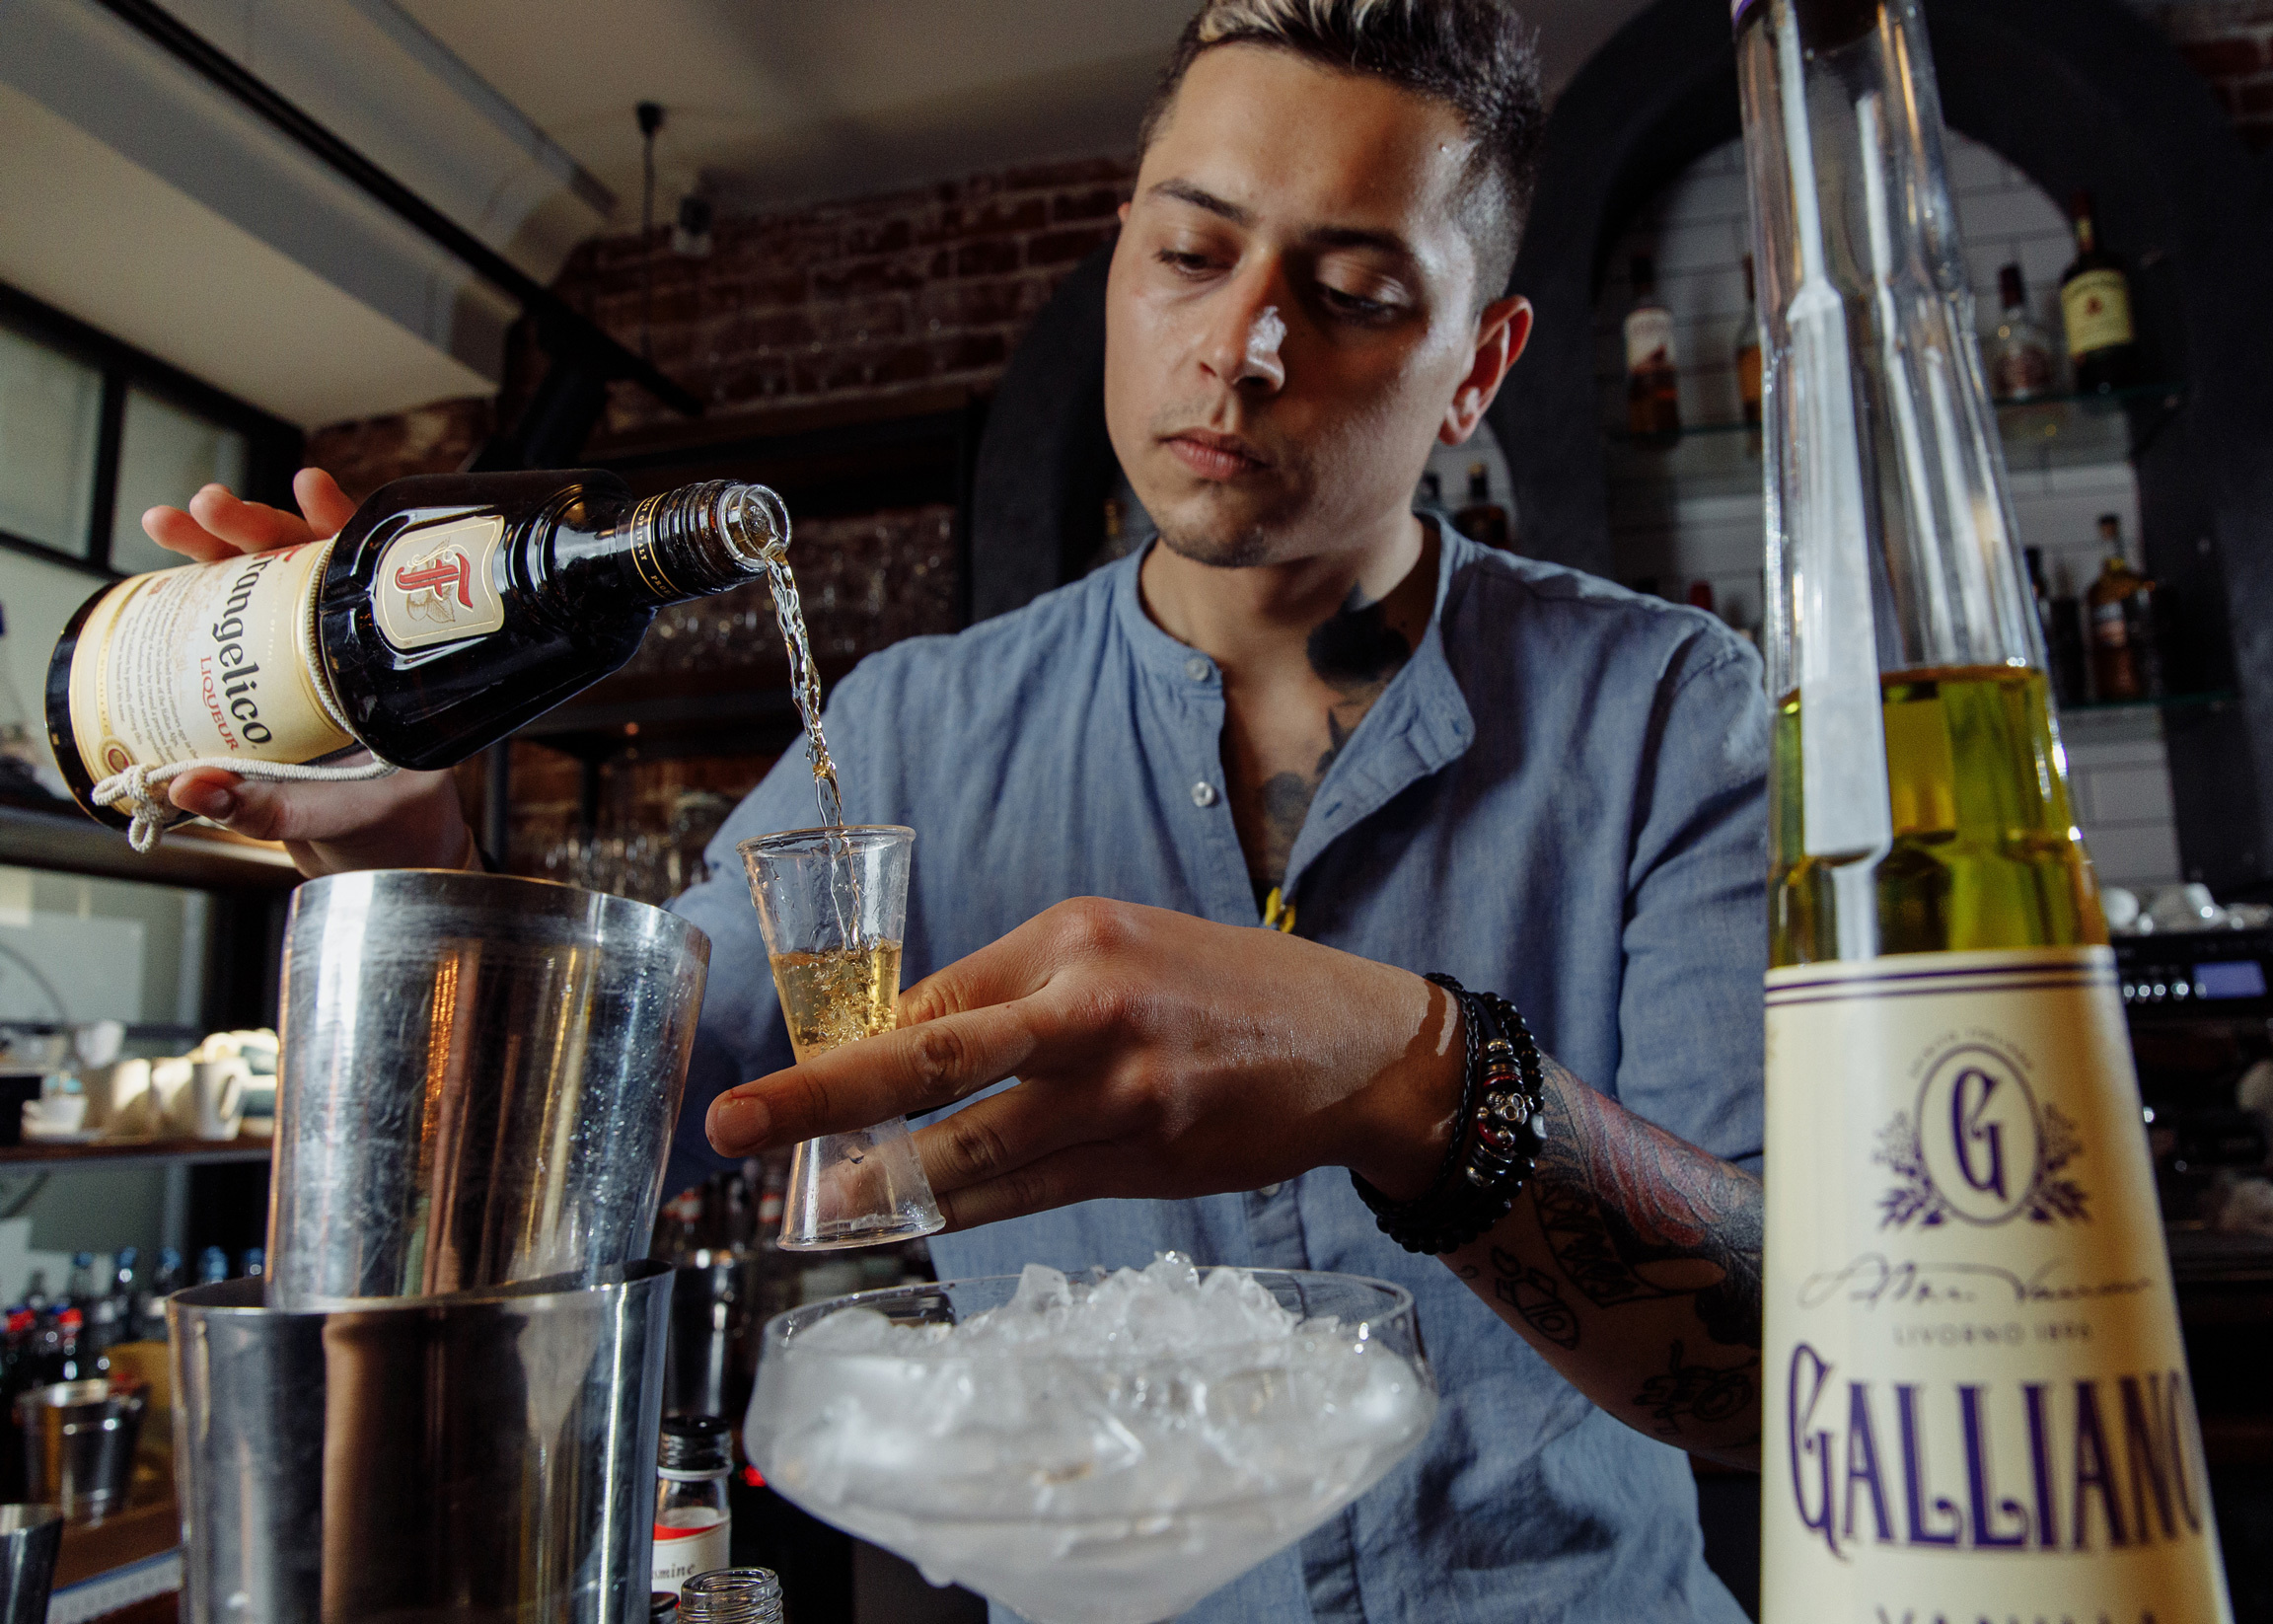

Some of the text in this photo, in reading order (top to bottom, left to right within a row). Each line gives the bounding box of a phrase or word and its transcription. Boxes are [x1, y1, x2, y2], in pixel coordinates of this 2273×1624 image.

[637, 531, 647, 560] ITALY
[200, 656, 239, 751] LIQUEUR
[1949, 1066, 2007, 1205] G
